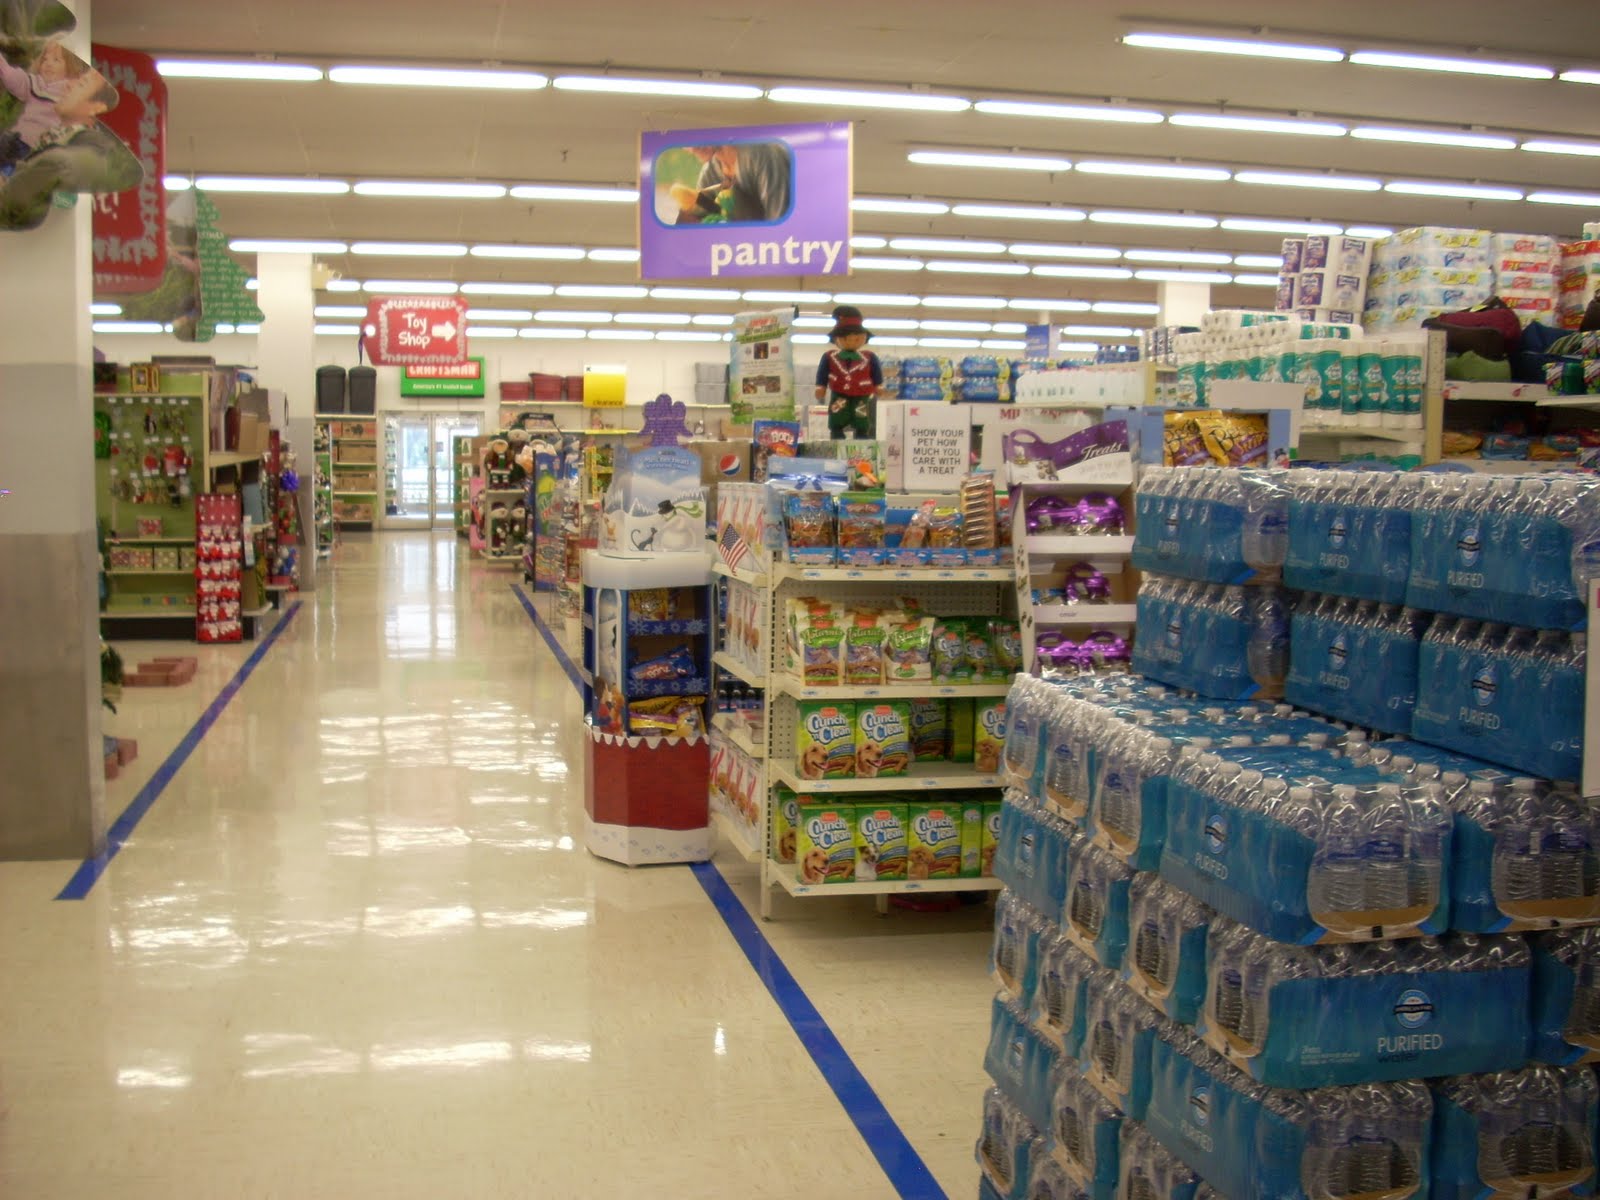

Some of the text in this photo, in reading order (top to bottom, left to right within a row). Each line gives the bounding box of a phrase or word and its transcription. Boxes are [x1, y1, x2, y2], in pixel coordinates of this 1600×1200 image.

[710, 235, 843, 276] pantry
[402, 311, 427, 335] Toy
[398, 331, 431, 349] Shop
[911, 428, 965, 438] SHOW YOUR
[913, 447, 960, 456] MUCH YOU
[917, 438, 958, 447] PET HOW
[1081, 441, 1122, 461] Treats
[912, 457, 961, 465] CARE WITH
[919, 466, 955, 475] A TREAT
[1447, 570, 1485, 589] PURIFIED
[1458, 706, 1501, 730] PURIFIED
[1377, 1033, 1443, 1053] PURIFIED
